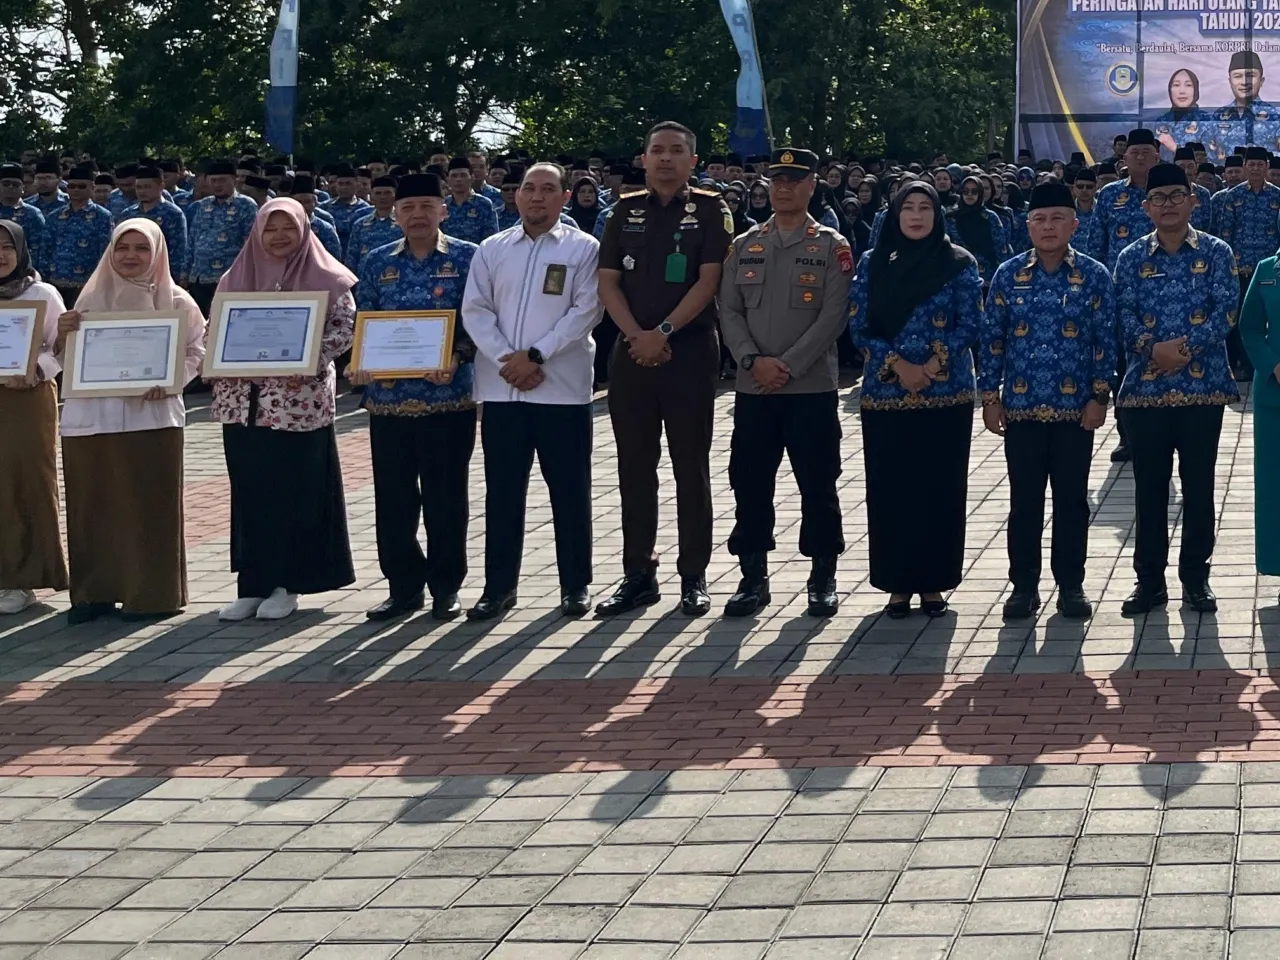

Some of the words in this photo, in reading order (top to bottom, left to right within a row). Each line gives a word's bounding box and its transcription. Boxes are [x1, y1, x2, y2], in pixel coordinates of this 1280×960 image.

[1200, 12, 1250, 30] TAHUN
[1179, 42, 1213, 53] Bersama
[1254, 41, 1280, 53] Dalam
[795, 257, 826, 267] POLRI
